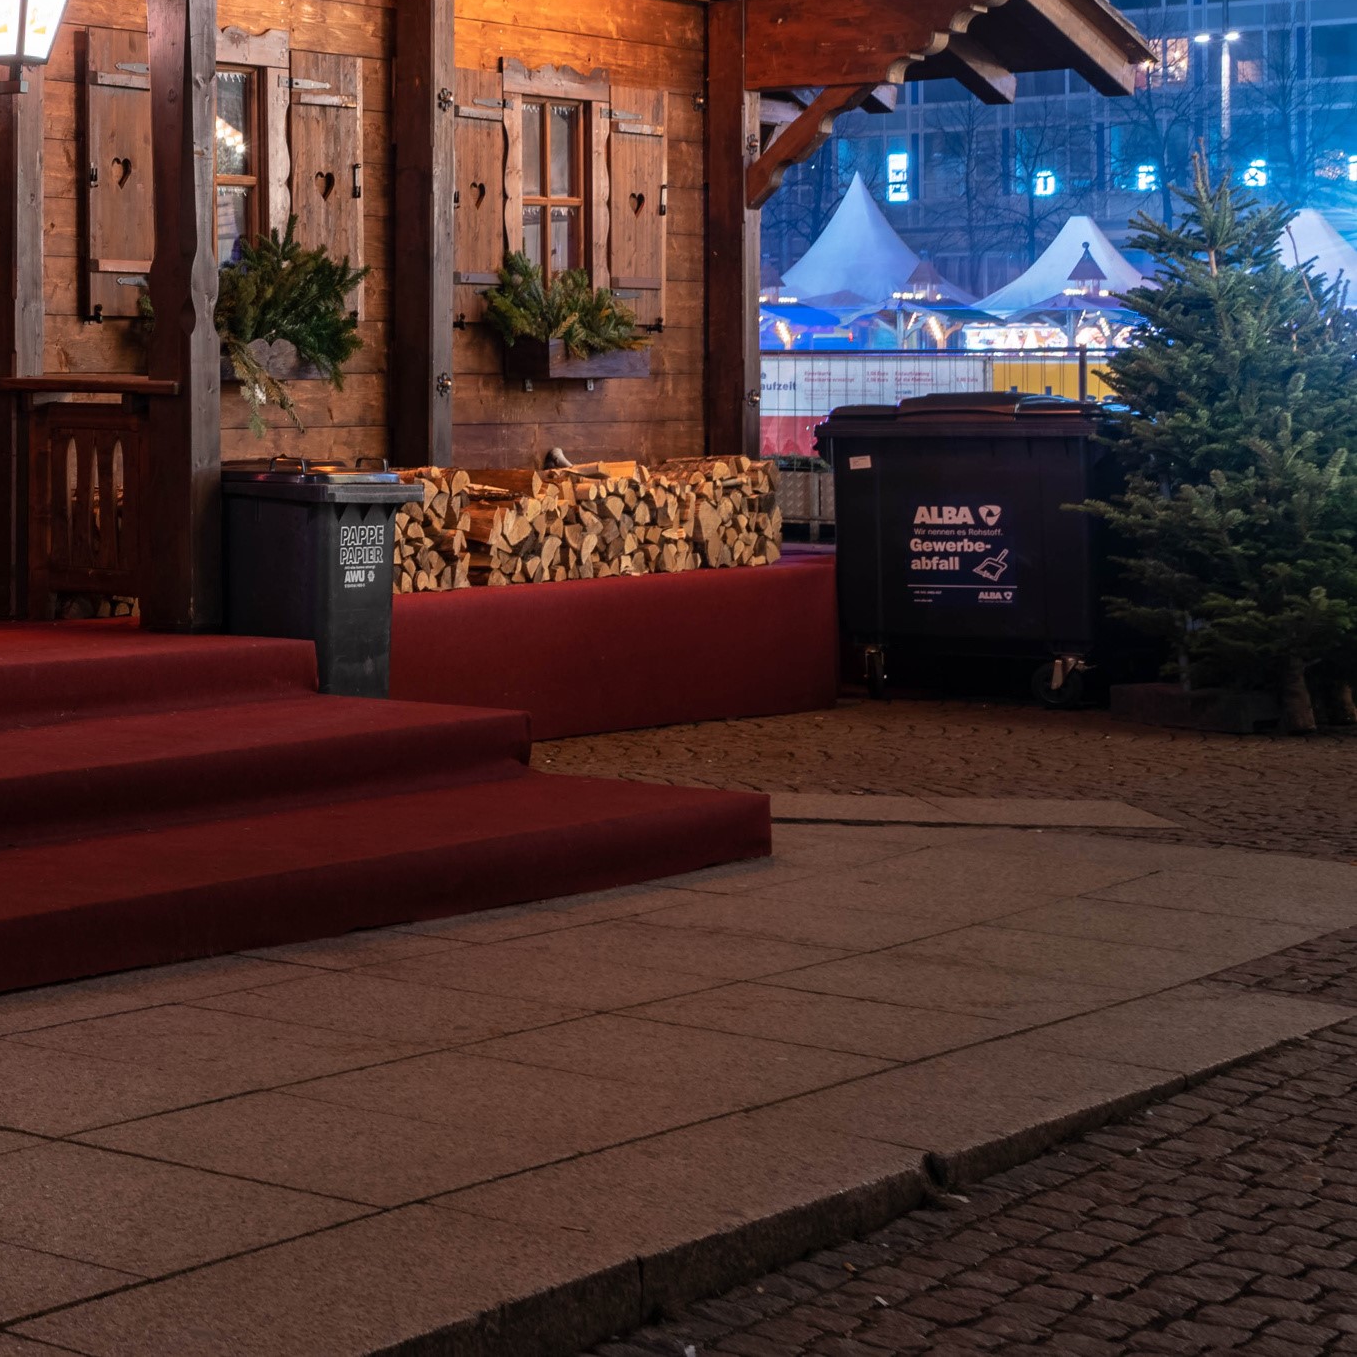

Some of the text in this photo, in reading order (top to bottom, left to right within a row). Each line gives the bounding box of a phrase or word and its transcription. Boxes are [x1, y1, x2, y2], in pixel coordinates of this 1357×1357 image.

[913, 506, 975, 524] ALBA
[340, 525, 385, 546] PAPPE
[968, 528, 1003, 536] Rohstoff.
[910, 538, 991, 552] Gewerbe-
[339, 546, 384, 565] PAPIER
[911, 557, 959, 570] abfall
[344, 570, 365, 583] AWU
